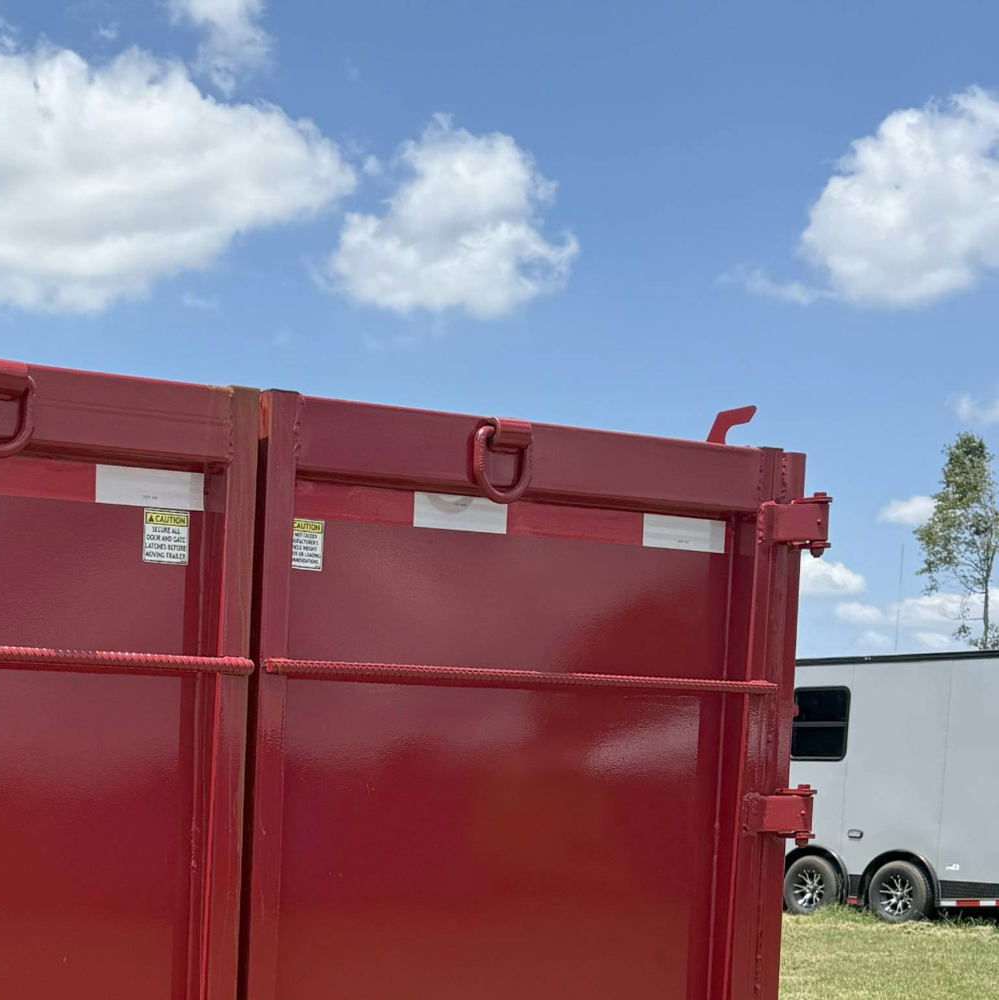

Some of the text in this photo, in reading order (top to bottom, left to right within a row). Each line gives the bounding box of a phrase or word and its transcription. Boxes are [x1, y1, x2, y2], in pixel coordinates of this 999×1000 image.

[155, 515, 186, 525] CAUTION
[152, 526, 170, 534] SECURE
[173, 536, 186, 544] GATE
[145, 543, 186, 552] LATCHES BEFORE
[166, 552, 186, 560] TRAILER
